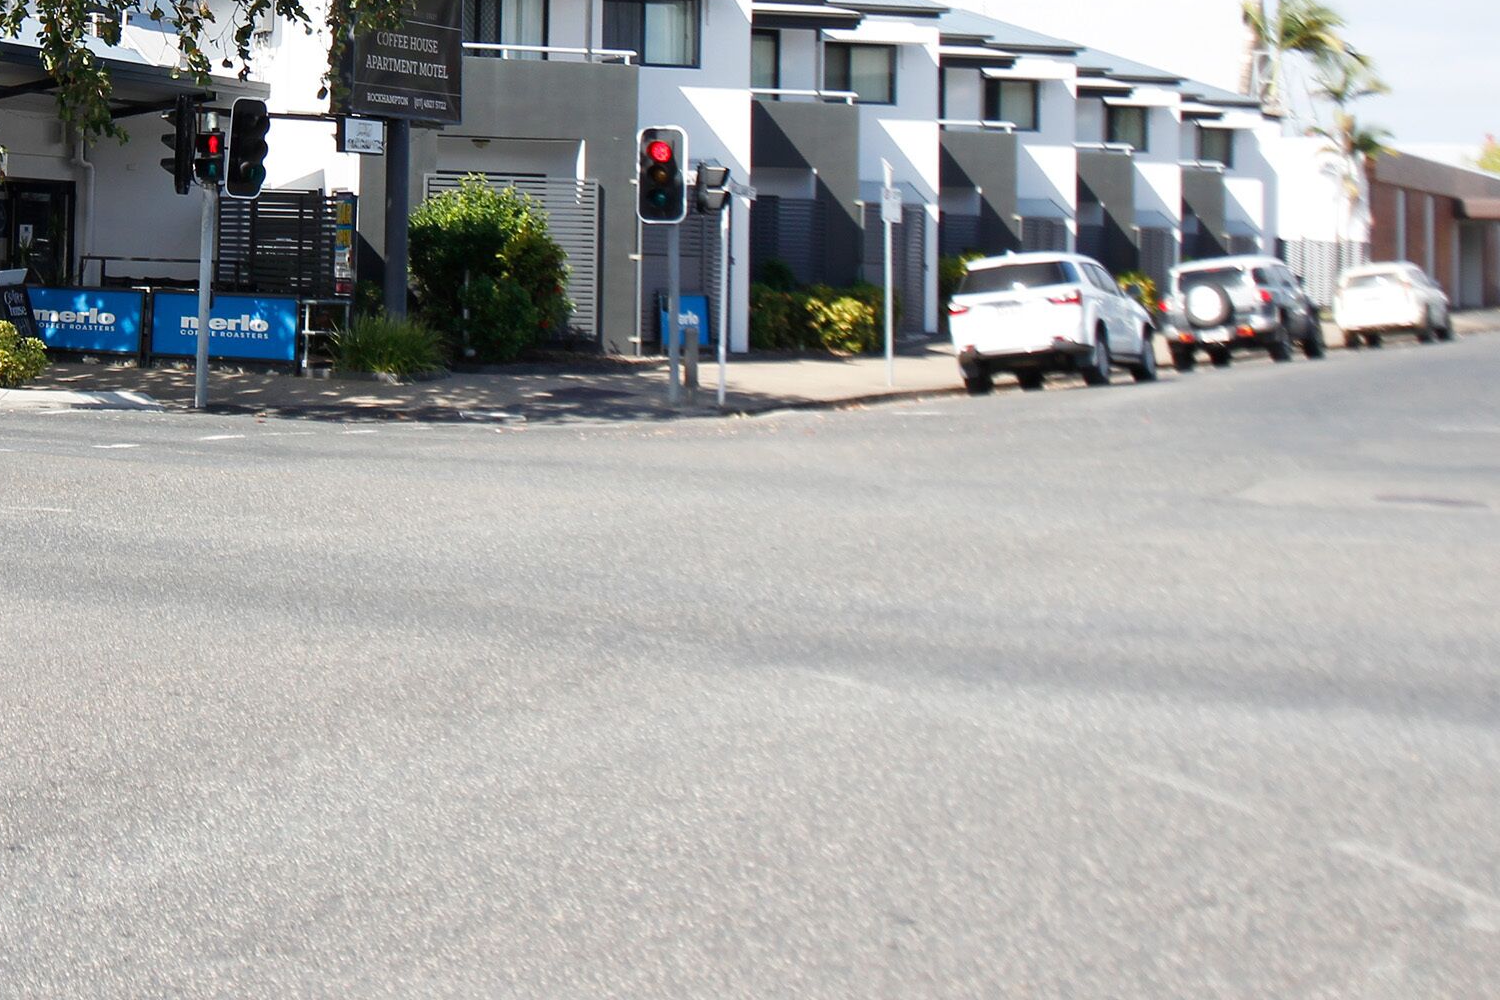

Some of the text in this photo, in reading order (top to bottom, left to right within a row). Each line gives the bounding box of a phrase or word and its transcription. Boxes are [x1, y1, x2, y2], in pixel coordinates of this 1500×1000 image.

[377, 31, 438, 54] COFFEE HOUSE
[366, 54, 449, 79] APARTMENT MOTEL
[367, 92, 409, 106] ROCKHAMPTON
[33, 308, 116, 325] merlo
[37, 321, 66, 329] OFFEE
[69, 324, 115, 332] ROASTERS
[220, 331, 269, 339] ROASTERS
